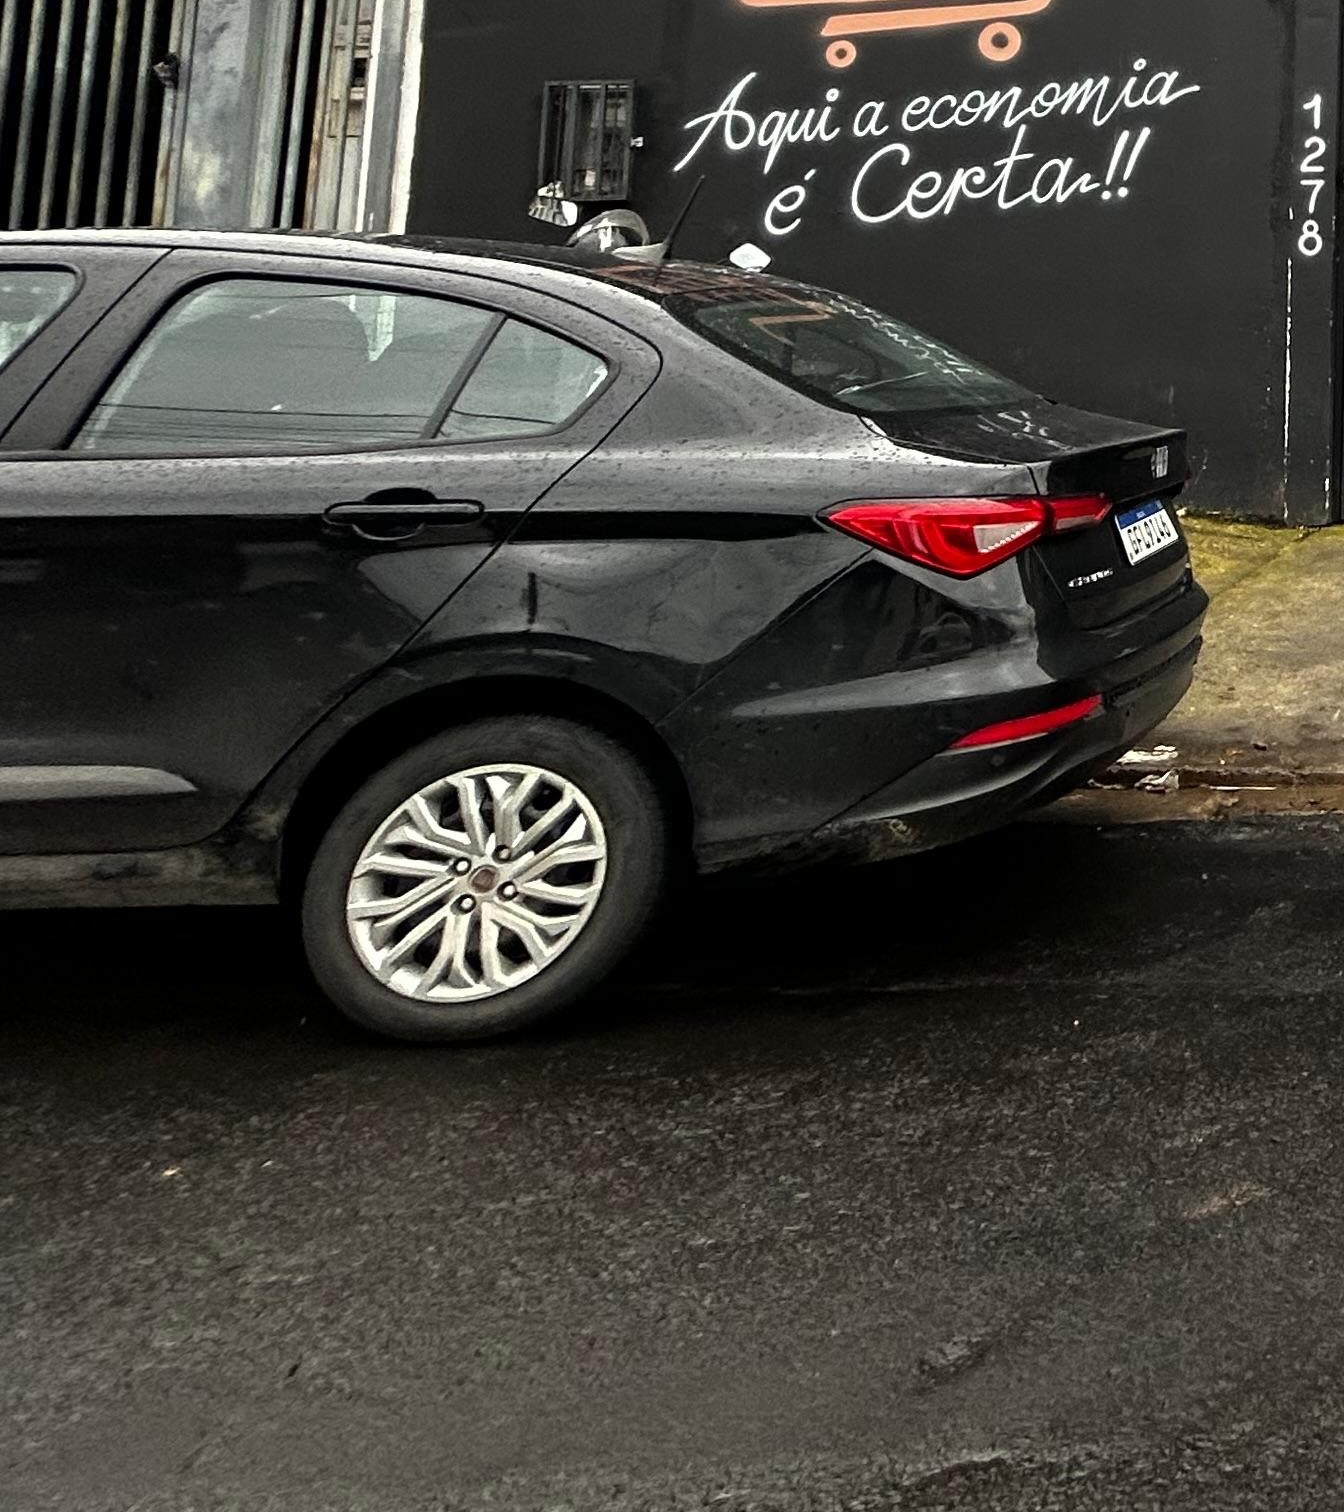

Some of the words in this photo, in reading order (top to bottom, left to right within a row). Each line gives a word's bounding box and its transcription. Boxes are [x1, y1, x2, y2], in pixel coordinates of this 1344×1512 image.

[673, 72, 841, 175] Aqui
[852, 100, 889, 138] a
[901, 58, 1201, 131] economia
[1298, 93, 1327, 257] 1278
[763, 168, 817, 236] é
